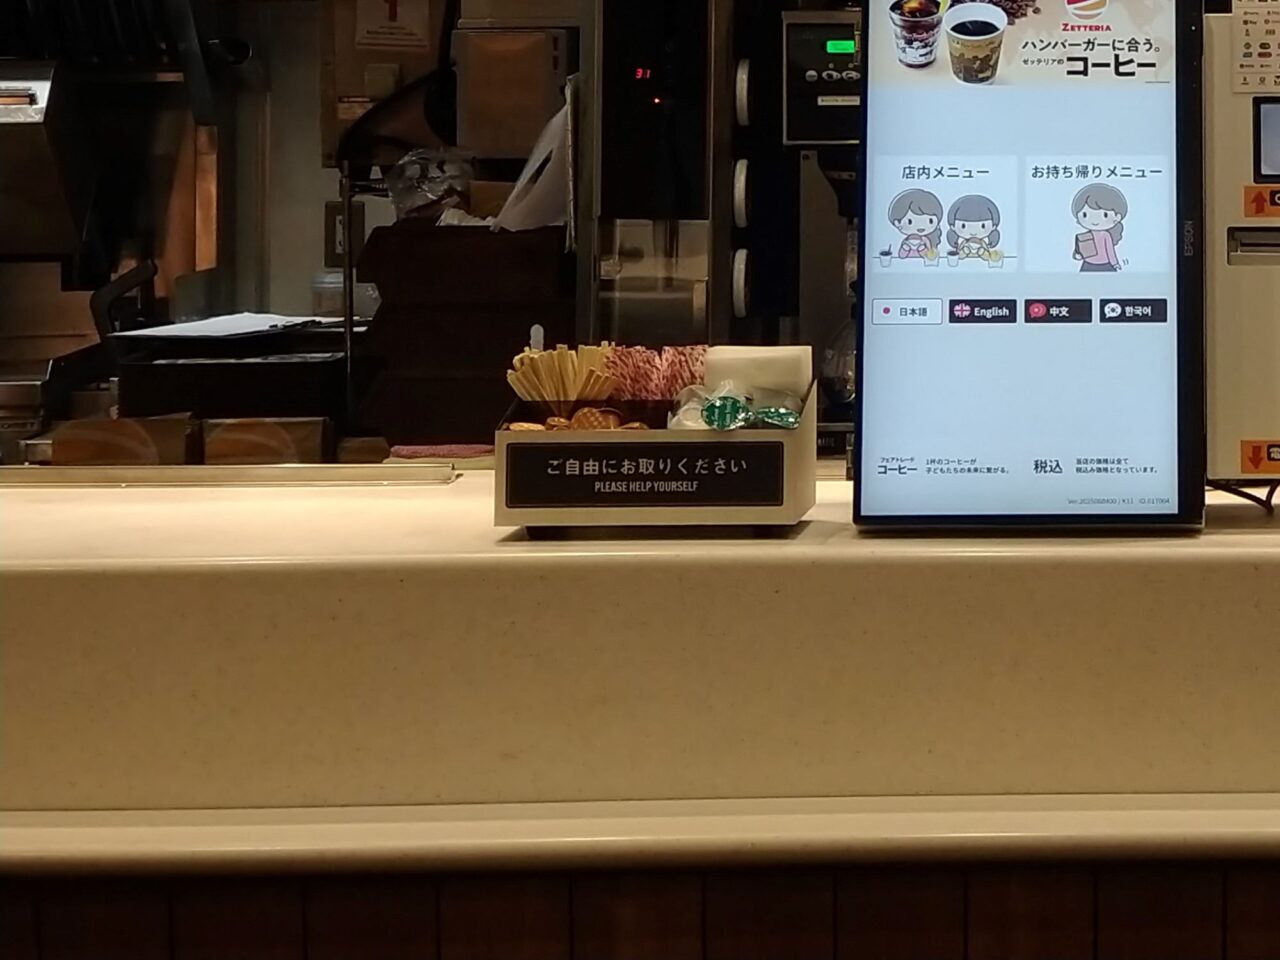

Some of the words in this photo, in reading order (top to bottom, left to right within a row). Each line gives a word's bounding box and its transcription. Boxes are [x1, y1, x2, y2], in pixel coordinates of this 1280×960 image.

[1061, 23, 1112, 32] ZETTERIA
[1021, 36, 1161, 53] ハンバーガーに合う。
[1066, 53, 1157, 77] コーヒー
[901, 165, 990, 180] 店内メニュー
[1031, 165, 1163, 180] お持ち帰りメニュー
[1183, 220, 1195, 257] EPSON
[899, 306, 928, 318] 日本語
[974, 306, 1010, 318] English
[1050, 306, 1070, 317] 中文
[1124, 306, 1152, 318] 한국어
[546, 457, 748, 476] ご自由にお取りください
[877, 464, 918, 475] コーヒー
[1033, 459, 1063, 475] 税込
[594, 480, 628, 493] PLEASE
[629, 481, 652, 493] HELP
[653, 480, 699, 493] YOURSELF
